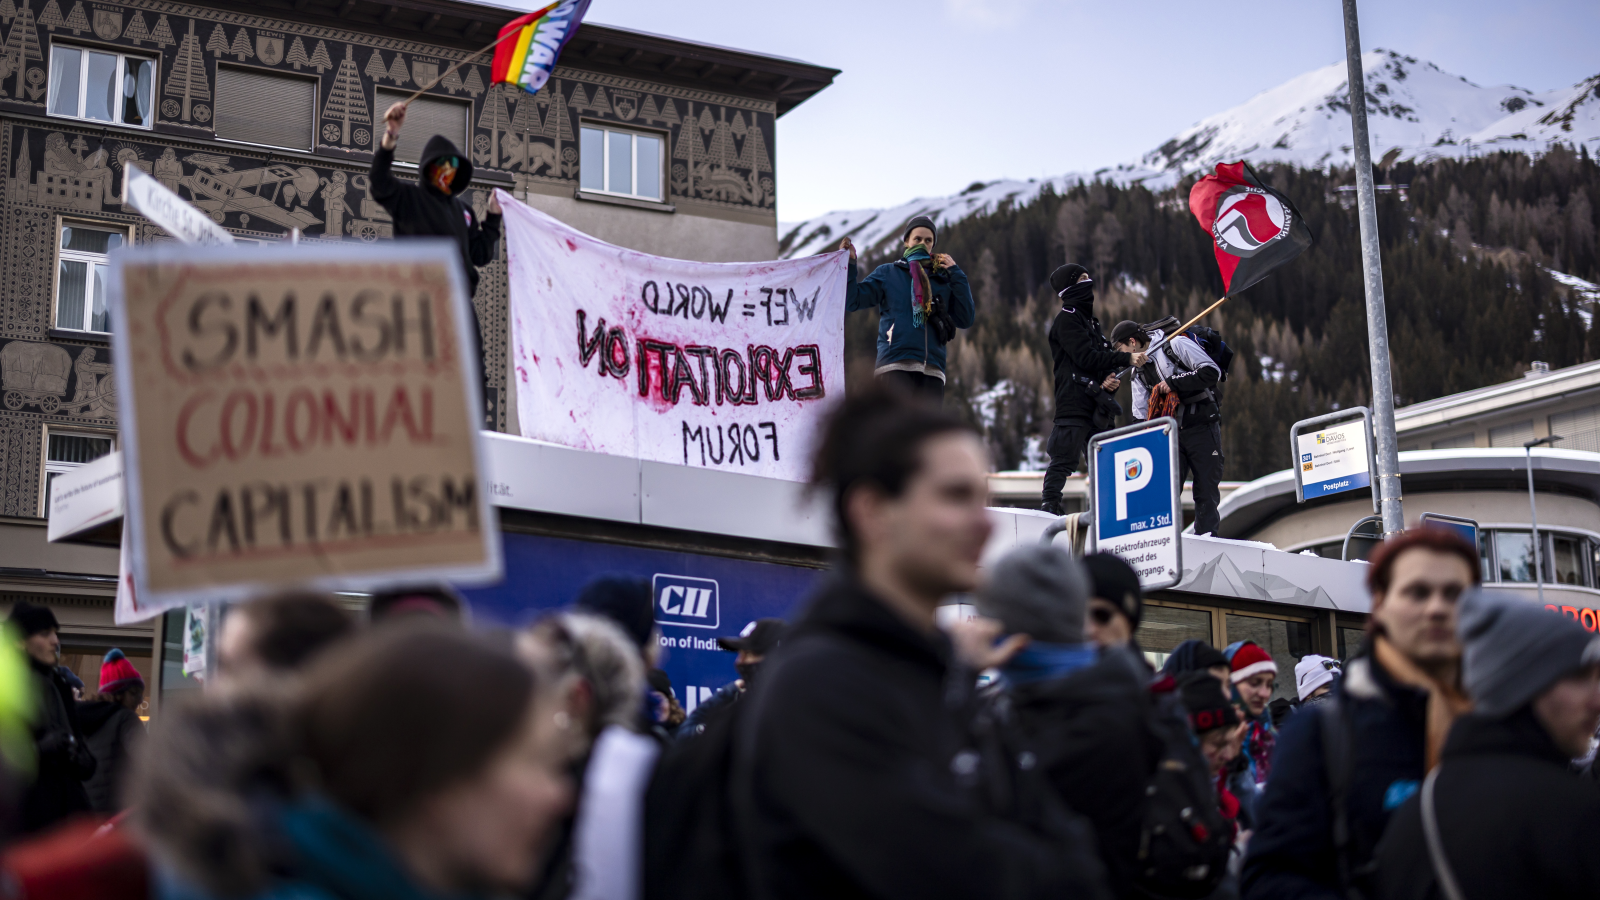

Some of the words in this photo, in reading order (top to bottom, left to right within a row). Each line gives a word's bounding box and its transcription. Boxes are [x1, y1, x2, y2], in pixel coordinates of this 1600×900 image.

[92, 3, 125, 13] SCHIERS
[256, 29, 286, 39] SEEWIS
[412, 55, 440, 64] MALANS
[520, 20, 568, 90] WAR
[181, 287, 437, 373] SMASH
[174, 383, 448, 470] COLONIAL
[1326, 433, 1345, 442] DAVOS
[1114, 447, 1153, 521] P
[1323, 481, 1349, 491] Postplatz
[160, 473, 478, 559] CAPITALISM
[1130, 520, 1148, 531] max.
[1150, 517, 1155, 528] 2
[1157, 513, 1171, 526] Std.
[1114, 537, 1170, 553] Elektrofahrzeuge
[1145, 553, 1157, 562] des
[659, 585, 713, 618] CII
[679, 636, 692, 648] of
